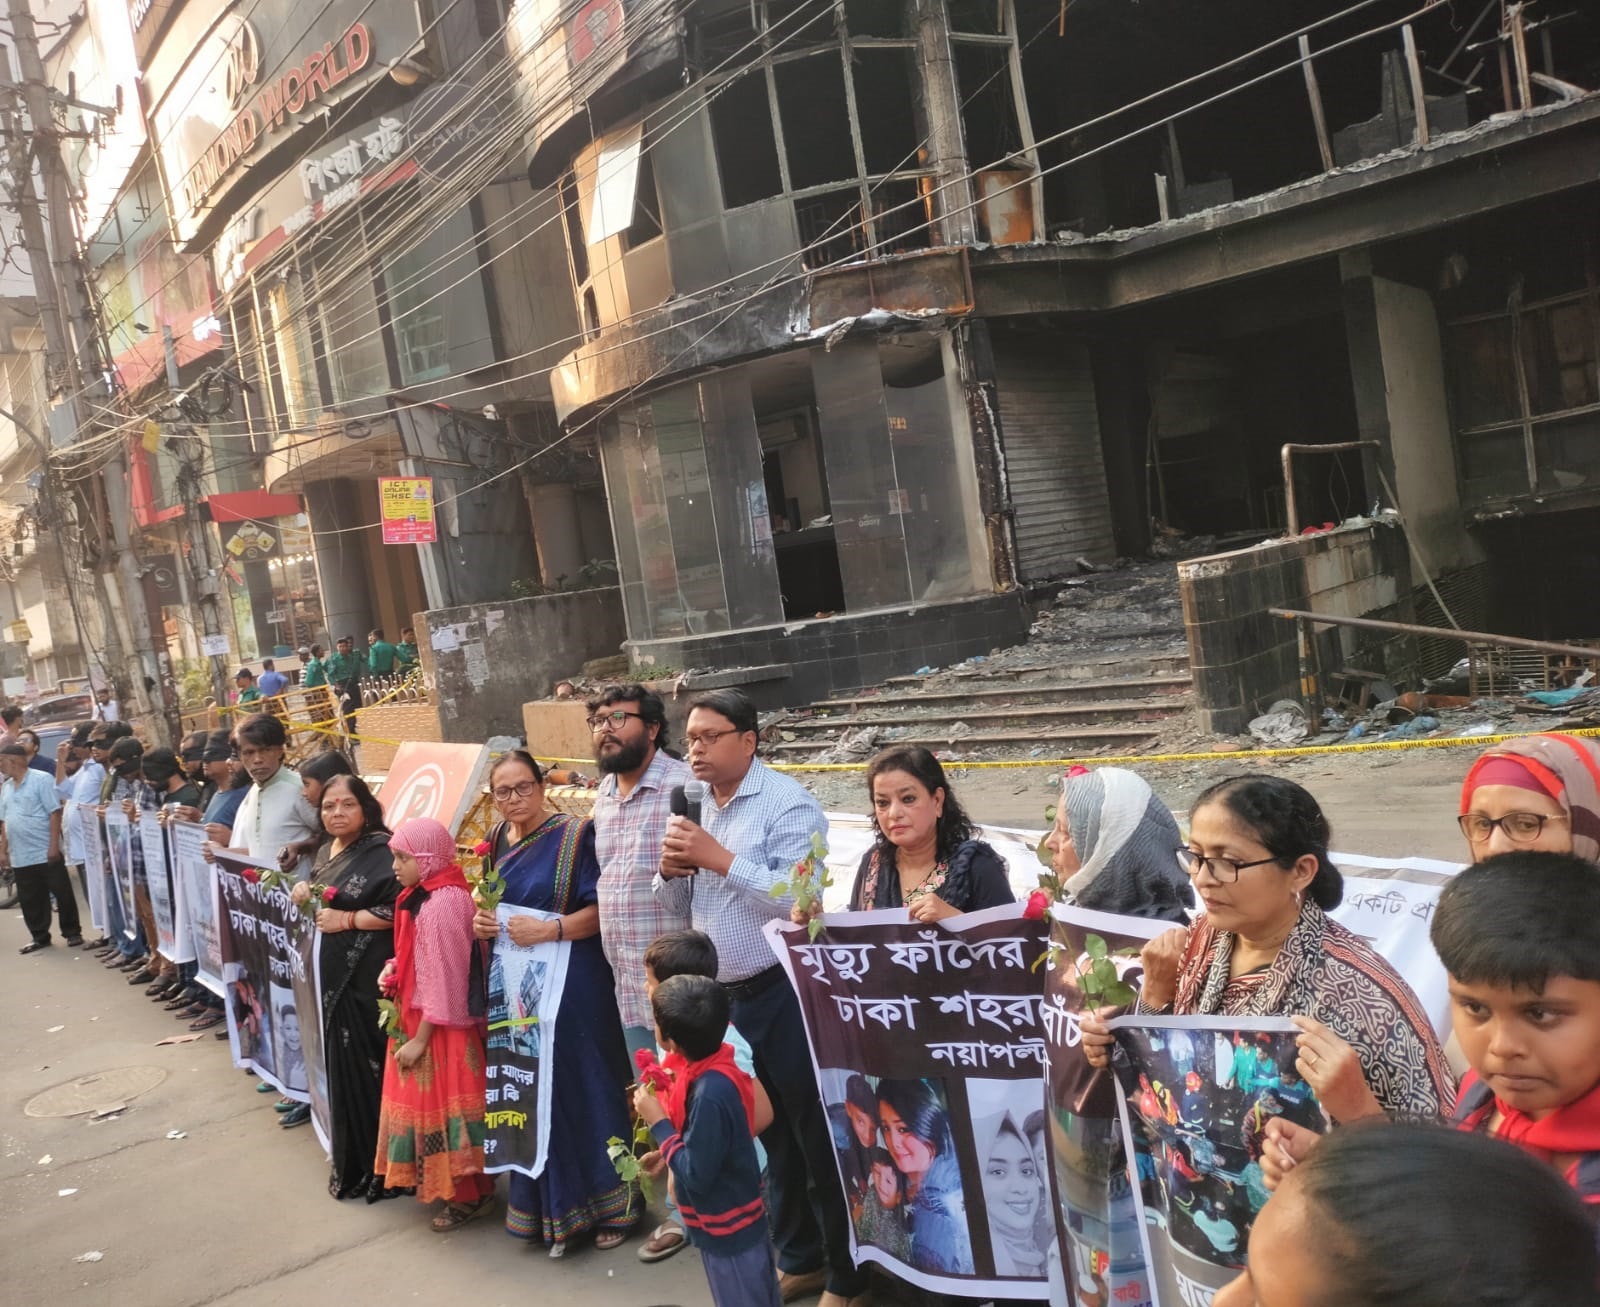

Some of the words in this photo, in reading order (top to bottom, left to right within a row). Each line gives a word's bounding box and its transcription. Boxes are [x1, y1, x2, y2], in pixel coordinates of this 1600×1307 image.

[184, 109, 257, 207] DIAMOND
[258, 21, 371, 134] WORLD
[790, 944, 876, 986] মৃত্যু
[884, 929, 1028, 974] ফাঁদের
[830, 995, 920, 1031] ঢাকা
[1039, 993, 1083, 1048] বাঁচ
[485, 1088, 500, 1105] রা
[503, 1082, 520, 1102] কি
[501, 1064, 535, 1086] যাদের
